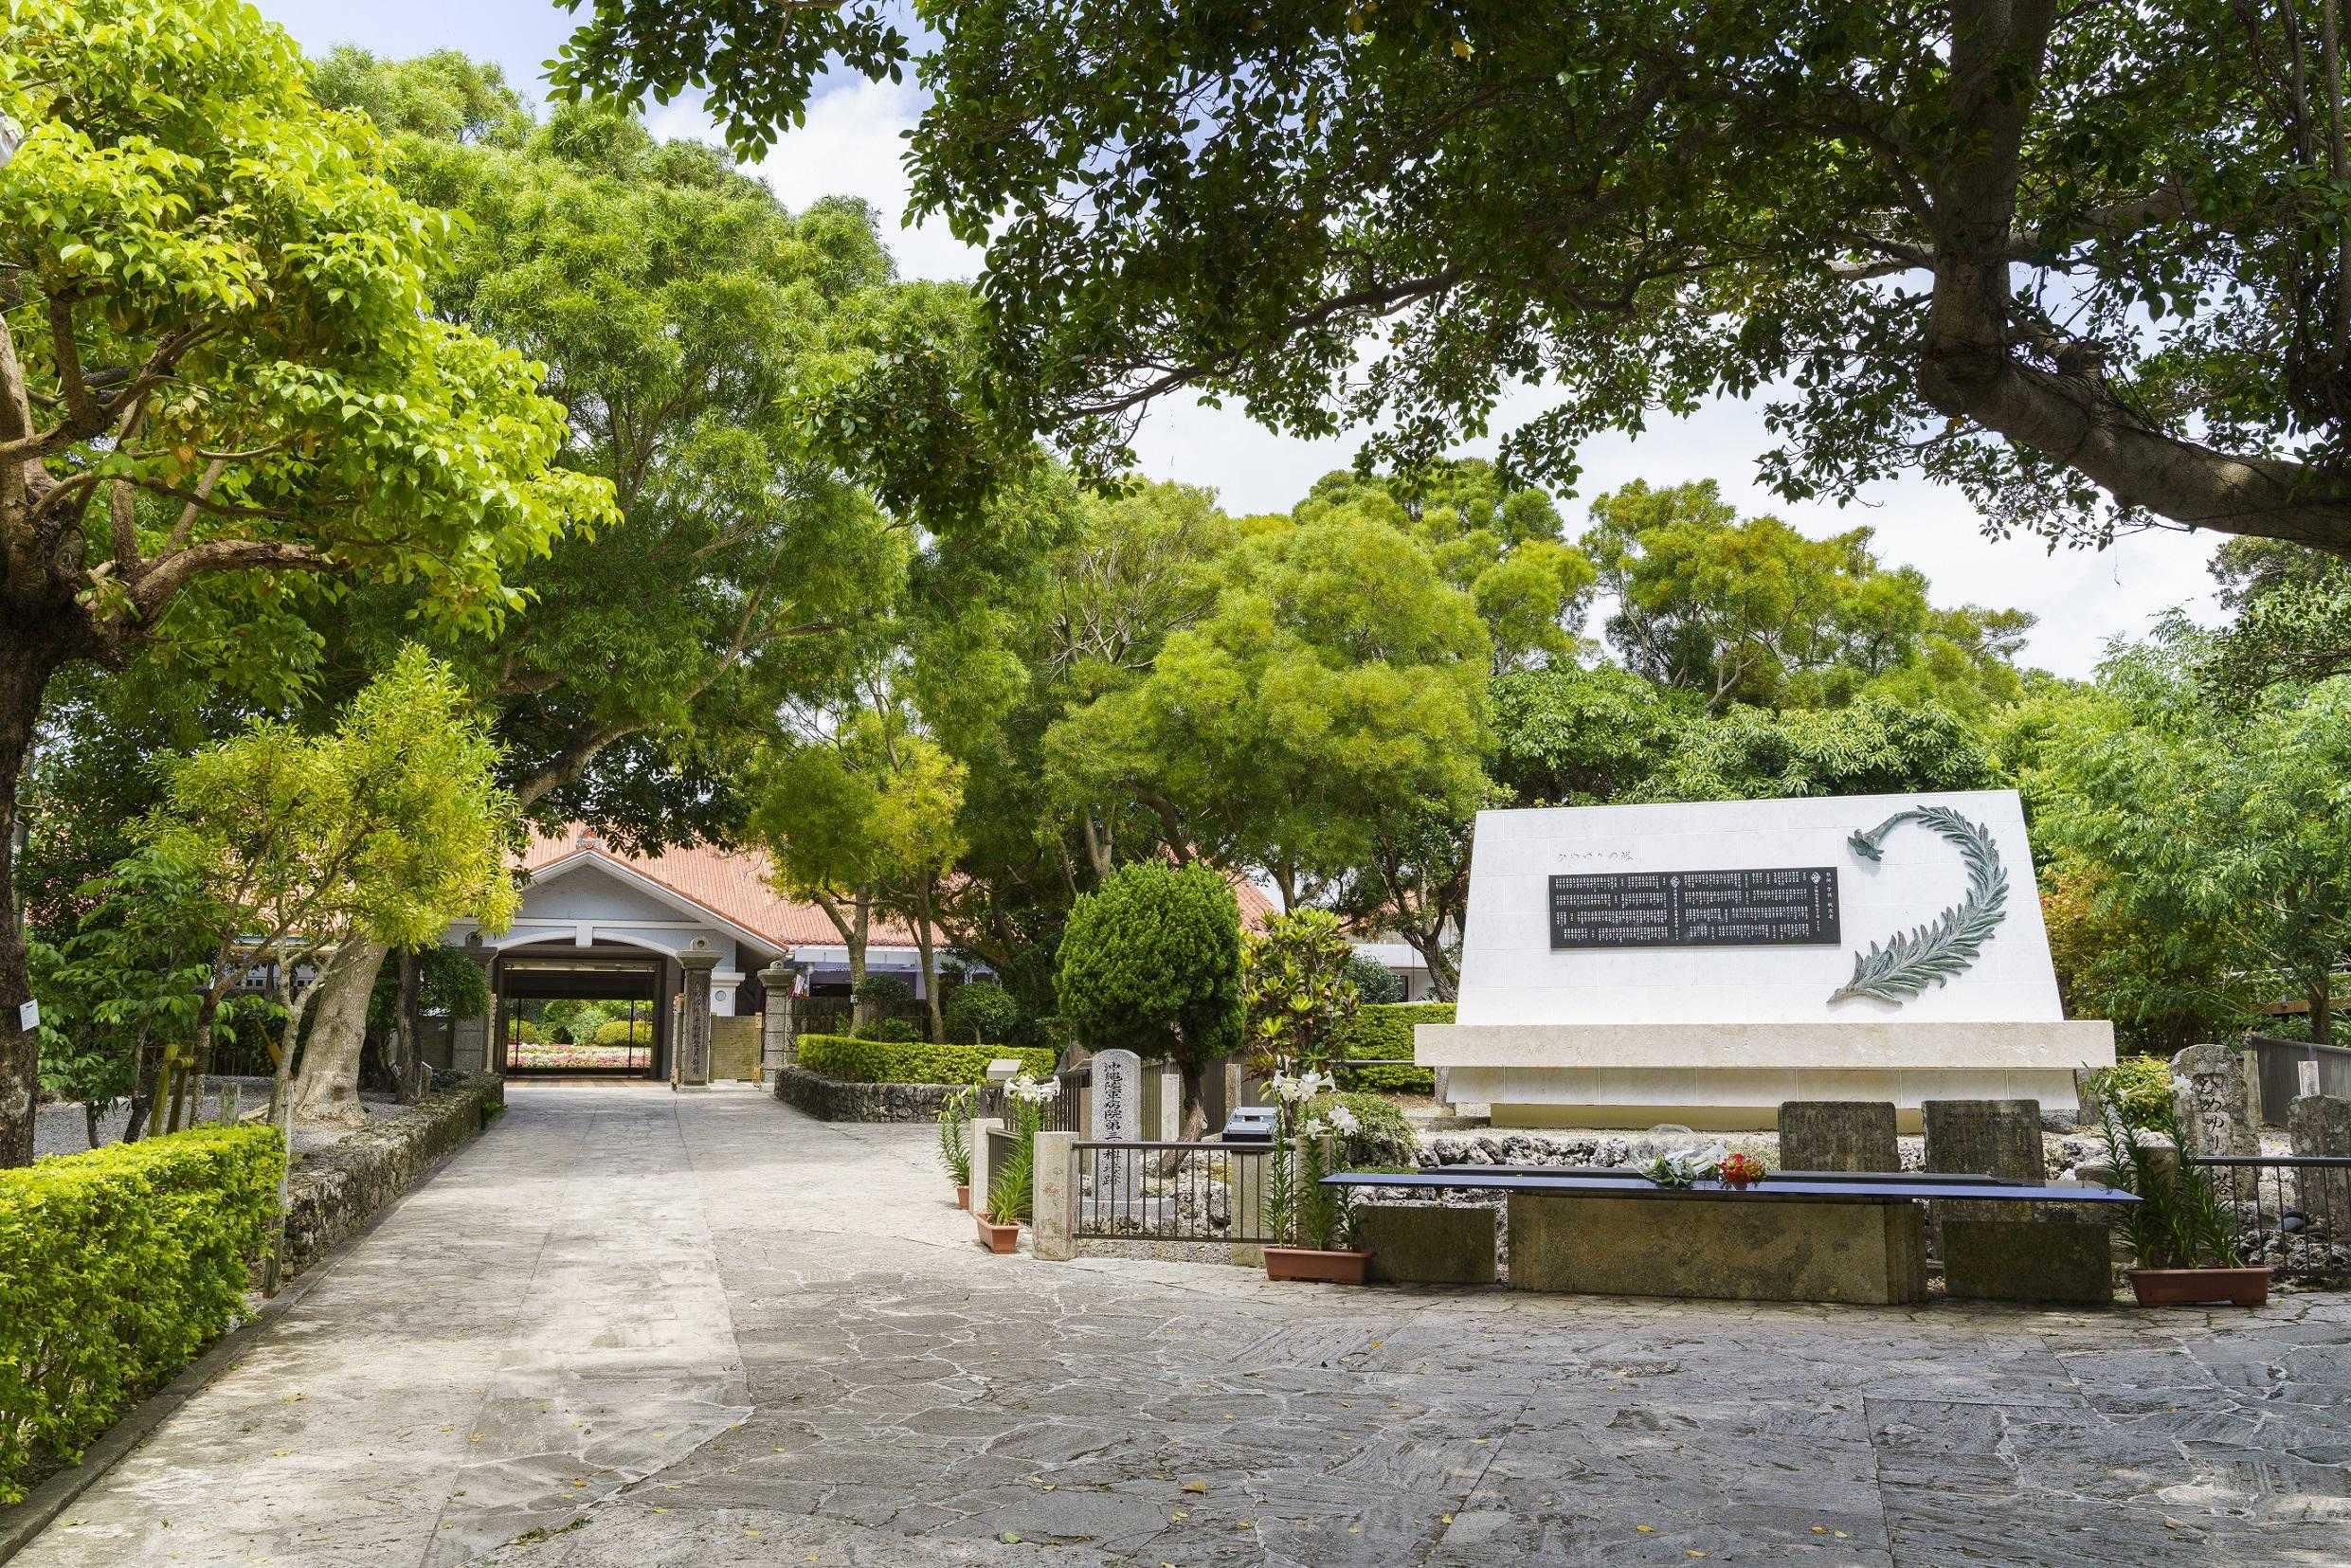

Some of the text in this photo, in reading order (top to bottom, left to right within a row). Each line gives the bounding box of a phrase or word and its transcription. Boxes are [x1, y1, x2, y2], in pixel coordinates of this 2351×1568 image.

[1102, 1061, 1124, 1185] 沖縄陸軍病院第三科壕跡
[2200, 1077, 2235, 1196] ひめゆり塔
